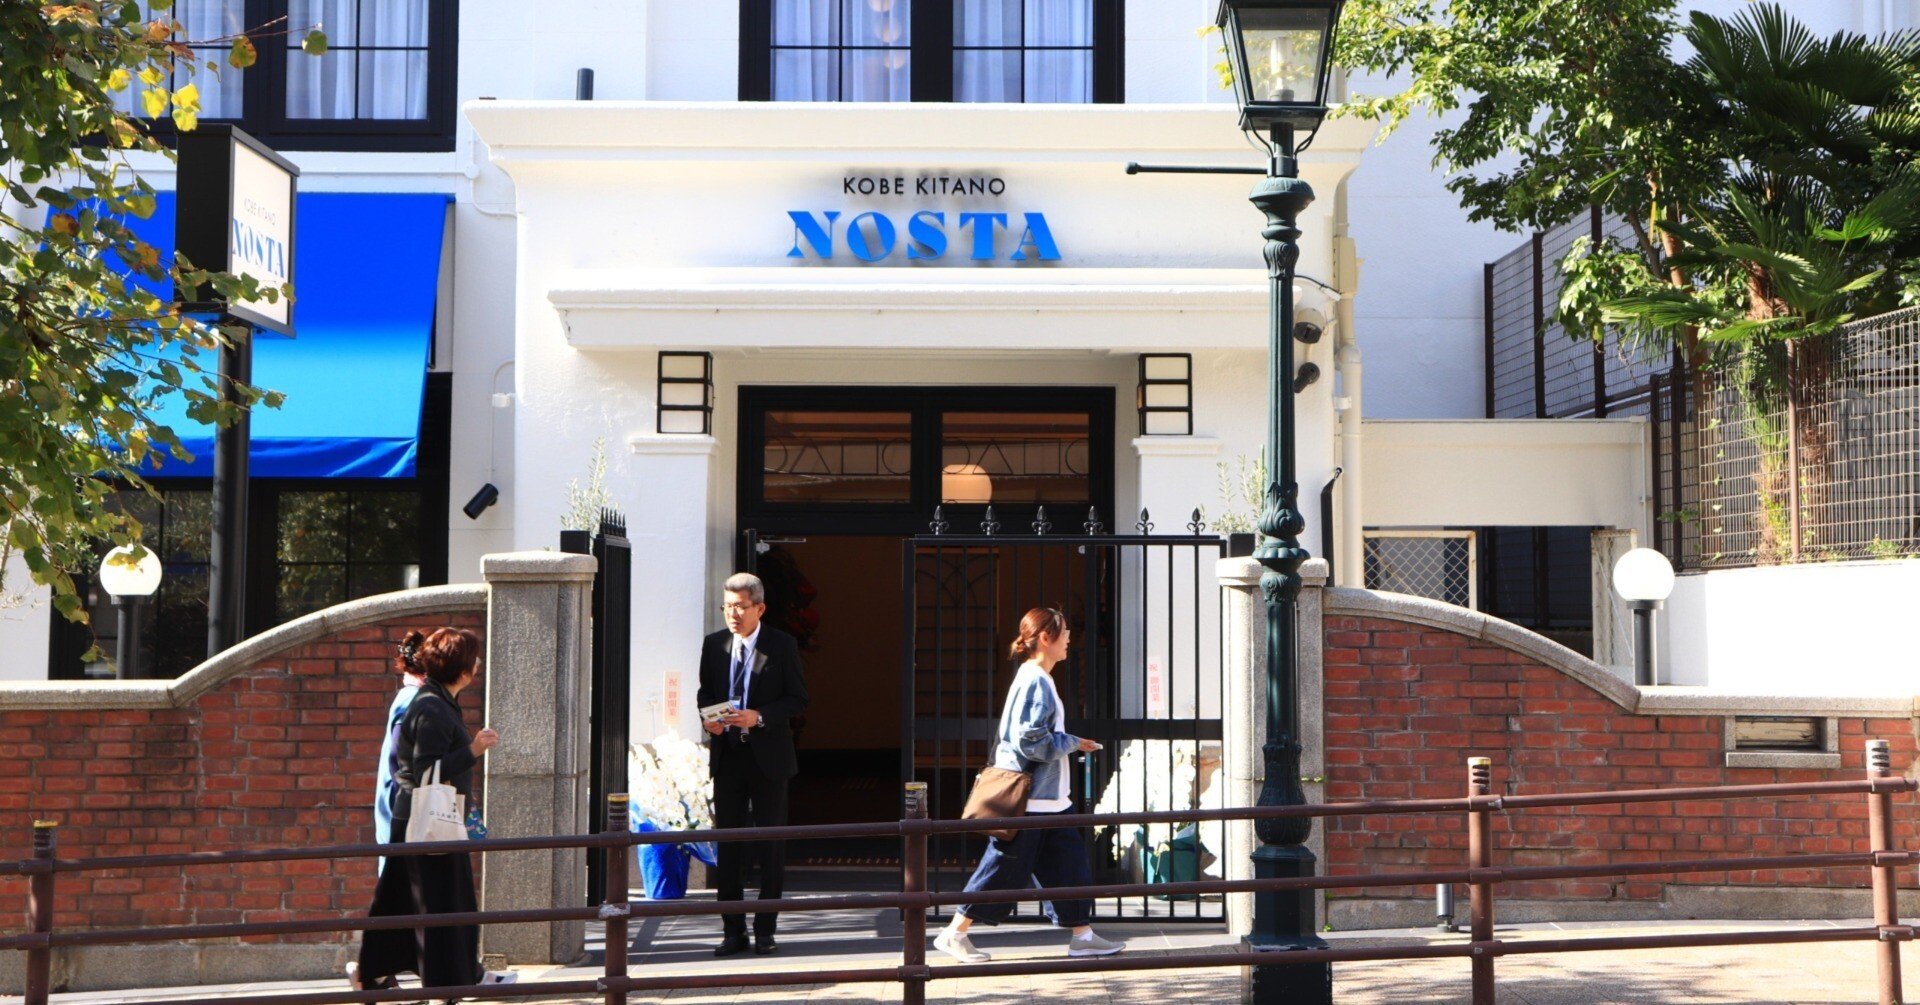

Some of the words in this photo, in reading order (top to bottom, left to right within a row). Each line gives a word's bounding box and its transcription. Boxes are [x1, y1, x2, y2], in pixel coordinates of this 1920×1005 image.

[843, 177, 904, 195] KOBE
[916, 177, 1006, 195] KITANO
[233, 218, 285, 279] NOSTA
[786, 210, 1063, 262] NOSTA
